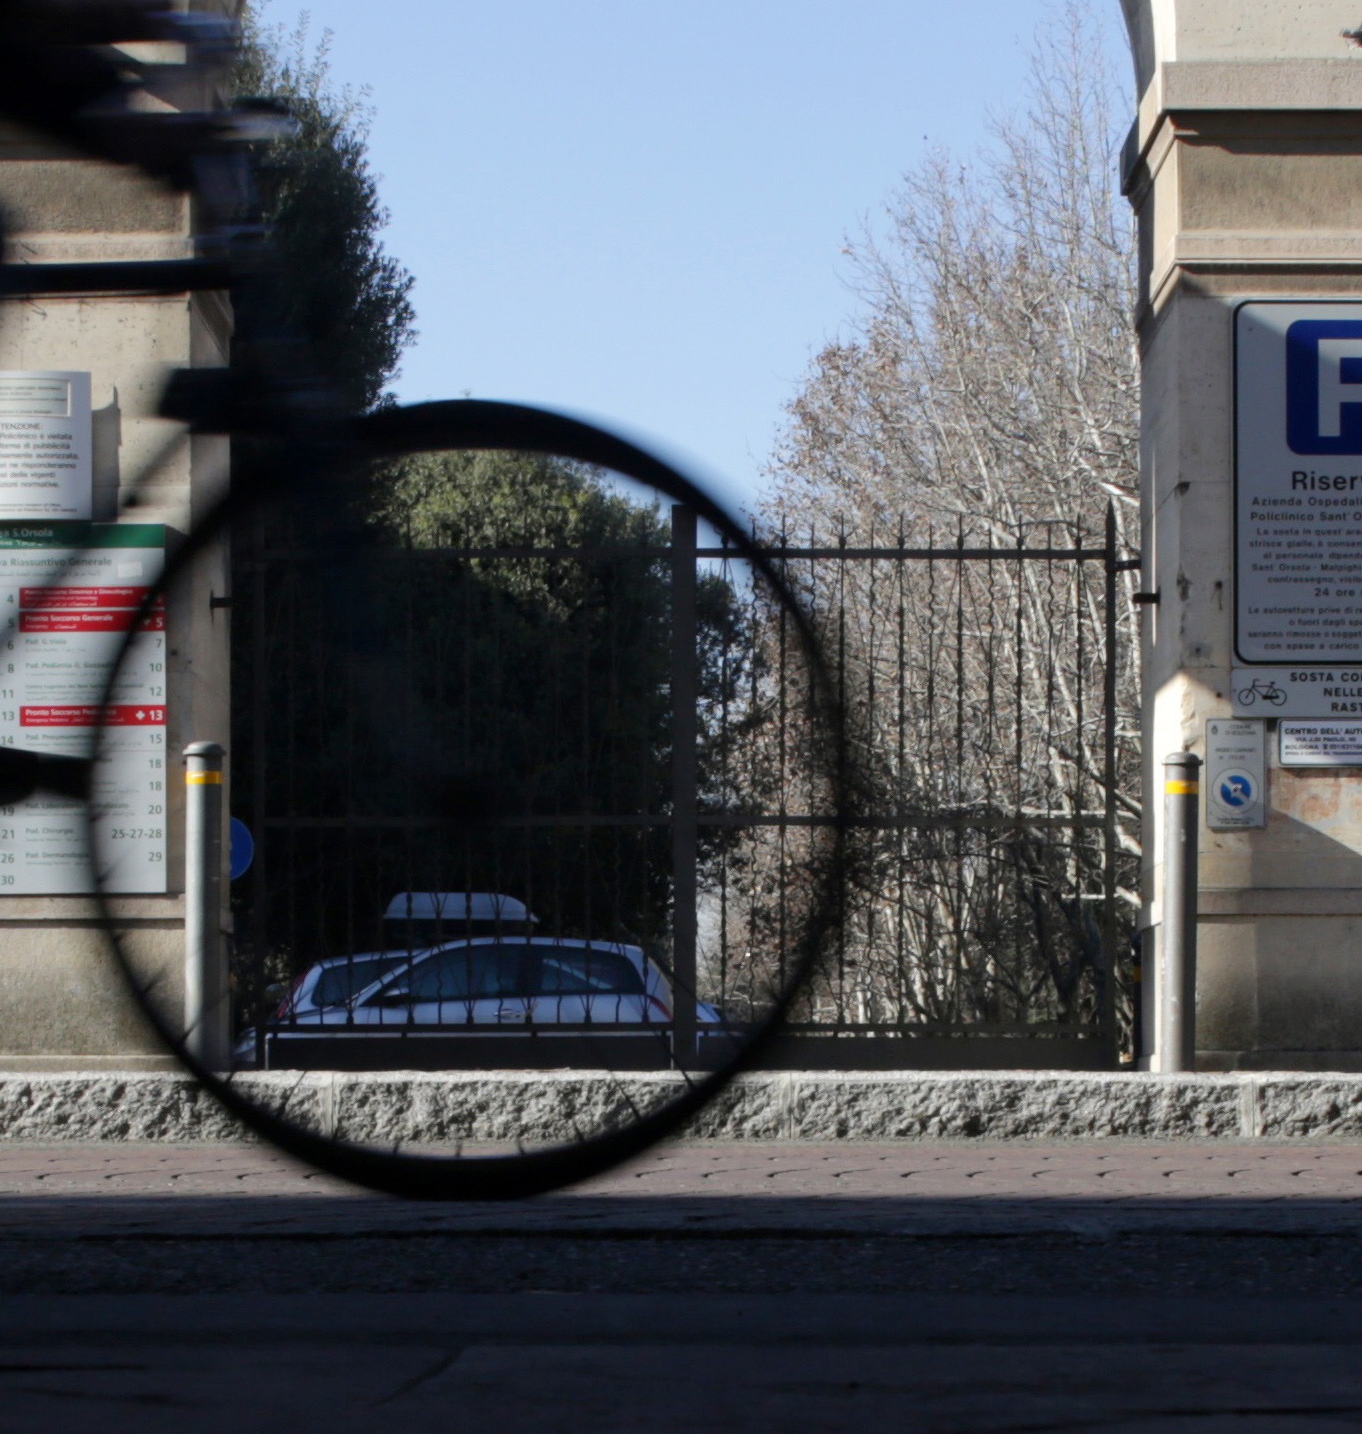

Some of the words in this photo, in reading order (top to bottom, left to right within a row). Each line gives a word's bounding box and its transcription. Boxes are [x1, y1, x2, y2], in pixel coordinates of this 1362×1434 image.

[1251, 496, 1302, 506] Azienda
[1250, 511, 1314, 521] Policlinico
[1314, 587, 1330, 597] 24
[1335, 589, 1356, 597] ore
[6, 594, 14, 603] 4
[7, 618, 15, 628] 5
[155, 617, 163, 628] 5
[7, 641, 14, 651] 6
[156, 638, 162, 648] 7
[7, 663, 15, 674] 8
[149, 662, 162, 672] 10
[1290, 672, 1334, 682] SOSTA
[1, 689, 14, 699] 11
[149, 686, 162, 696] 12
[1, 711, 15, 721] 13
[149, 709, 163, 721] 13
[1284, 727, 1318, 735] CENTRO
[1, 736, 14, 745] 14
[149, 734, 163, 744] 15
[148, 759, 162, 769] 18
[148, 781, 162, 791] 18
[1, 806, 14, 816] 19
[148, 805, 162, 814] 20
[1, 829, 15, 839] 21
[111, 829, 162, 839] 25-27-28
[0, 854, 14, 864] 26
[148, 852, 162, 862] 29
[0, 875, 15, 885] 30
